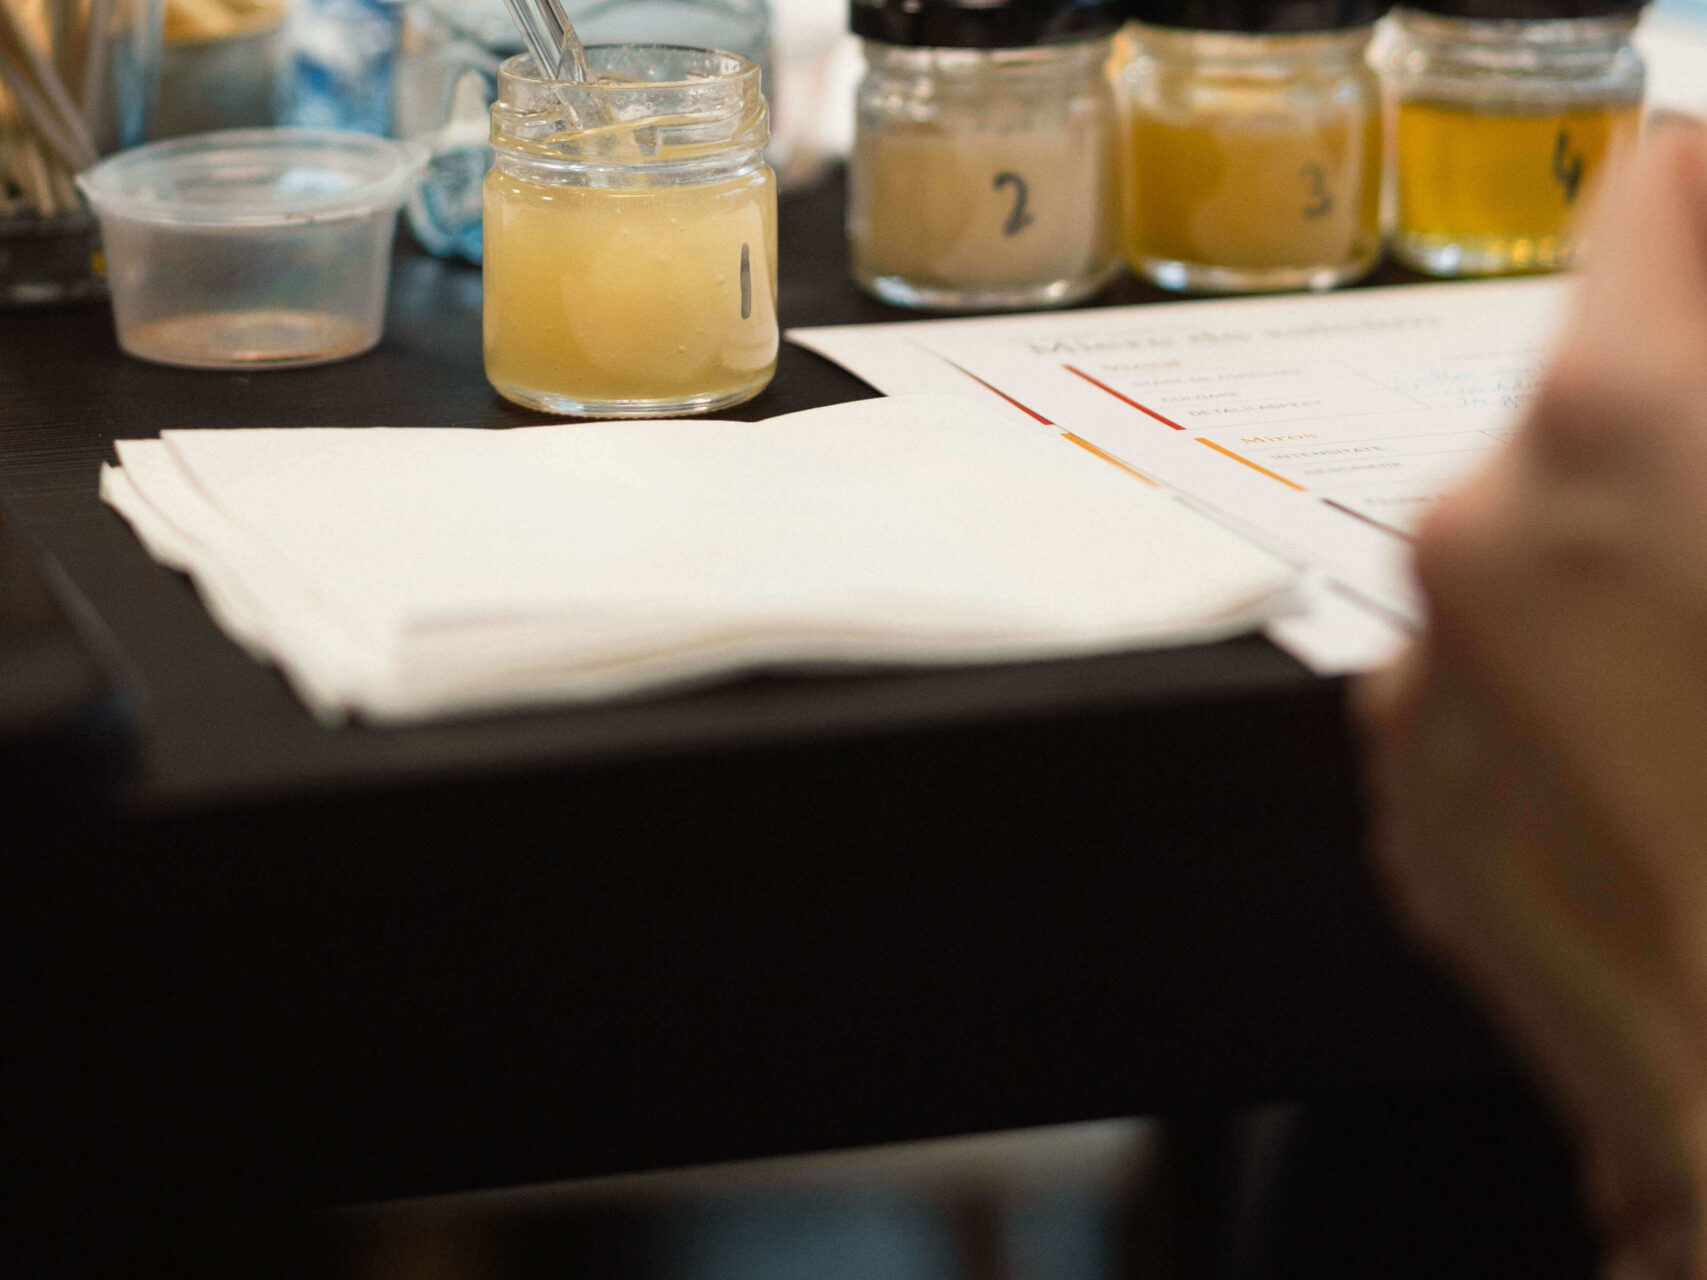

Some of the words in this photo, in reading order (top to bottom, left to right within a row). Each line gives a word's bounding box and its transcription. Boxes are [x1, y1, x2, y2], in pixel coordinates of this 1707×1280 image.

[993, 171, 1035, 237] 2
[1239, 433, 1319, 446] Miros
[1270, 446, 1387, 460] INTENSITATE
